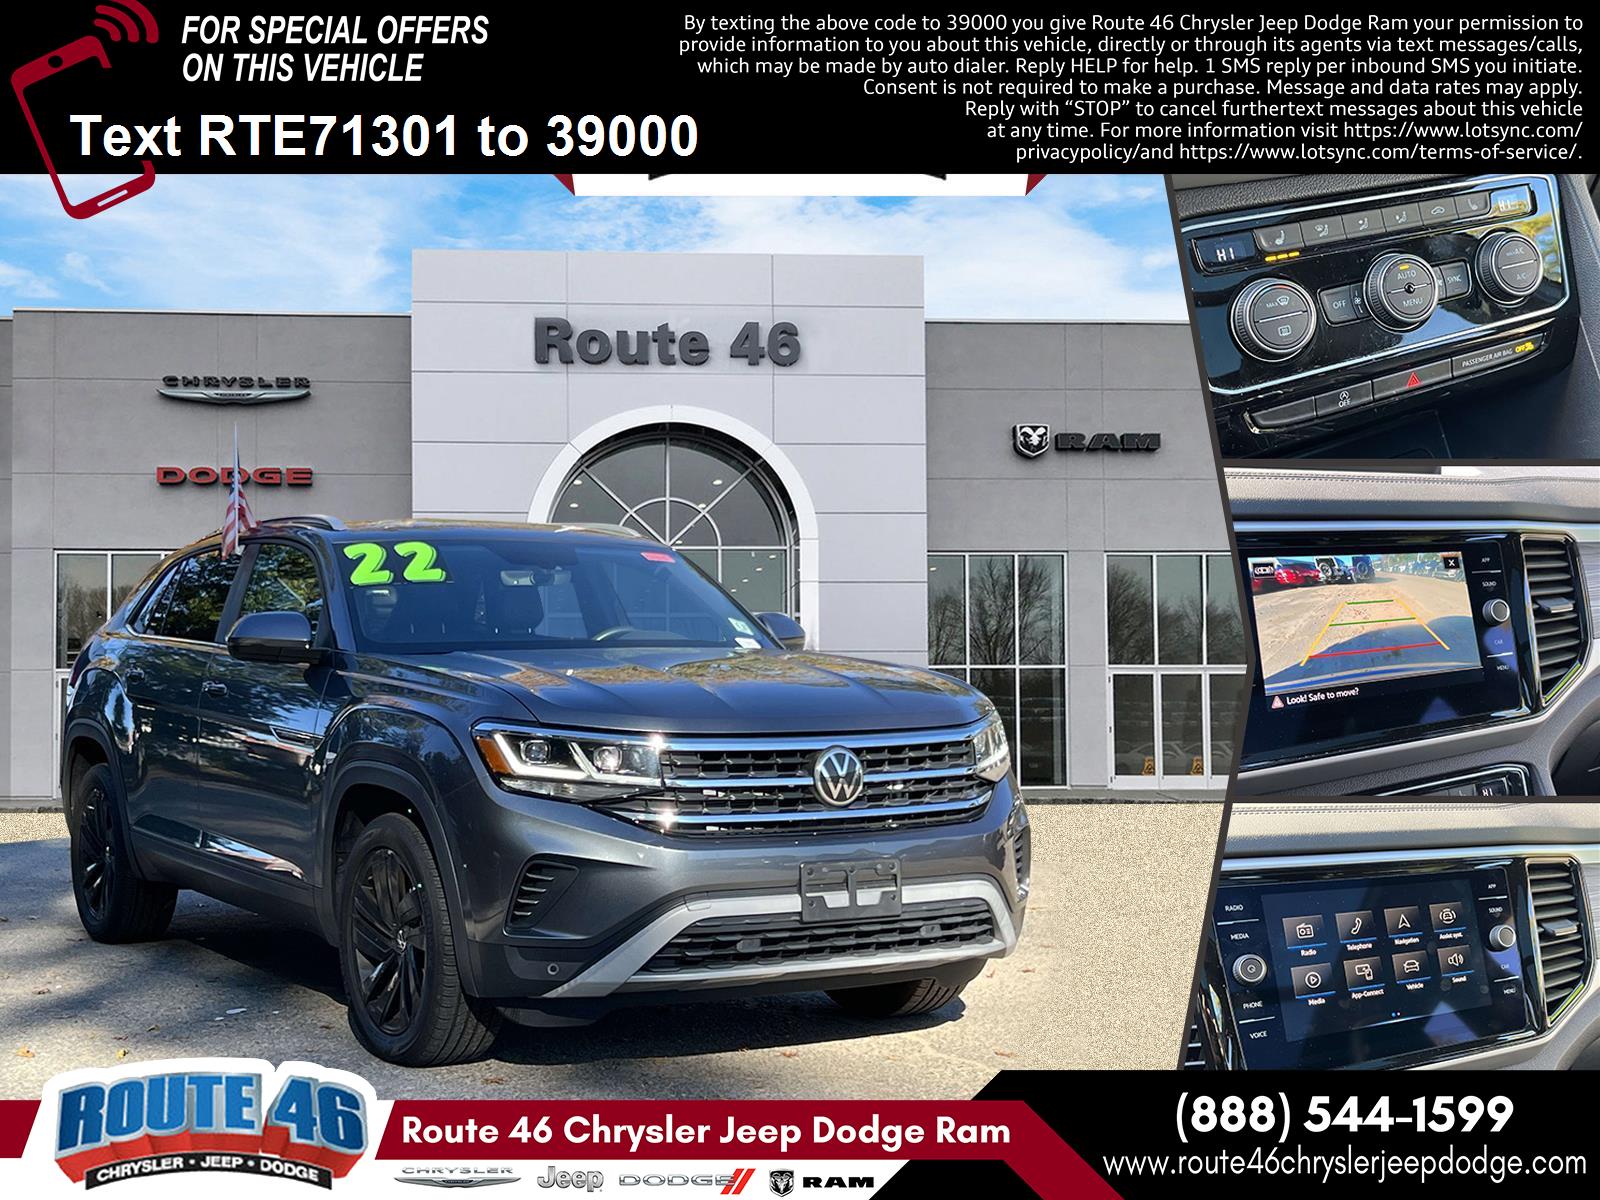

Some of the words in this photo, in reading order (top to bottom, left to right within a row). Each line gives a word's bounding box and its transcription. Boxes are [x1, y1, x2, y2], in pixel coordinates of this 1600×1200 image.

[1216, 247, 1235, 262] HI
[1397, 270, 1417, 280] AUTO
[1447, 275, 1462, 284] SYNC
[1332, 300, 1347, 309] OFF
[1402, 297, 1424, 307] MENU
[534, 317, 711, 366] Route
[729, 321, 801, 367] 46
[1462, 354, 1493, 368] PASSENGER
[162, 375, 311, 388] CHRYSLER
[1338, 400, 1351, 408] OFF
[1054, 433, 1162, 453] RAM
[156, 466, 314, 486] DODGE
[343, 541, 446, 586] 22
[1286, 695, 1308, 705] Look!
[1308, 692, 1326, 702] Safe
[1326, 691, 1335, 700] to
[1336, 687, 1360, 698] move?
[1225, 904, 1244, 912] RADIO
[1230, 932, 1250, 940] MEDIA
[1395, 937, 1420, 946] Navigation
[1347, 943, 1373, 952] Telephone
[1301, 949, 1317, 957] Radio
[1452, 975, 1467, 983] Sound
[1352, 989, 1385, 999] App-Connect
[1243, 1001, 1263, 1009] PHONE
[1308, 997, 1326, 1006] Media
[1249, 1031, 1268, 1039] VOICE
